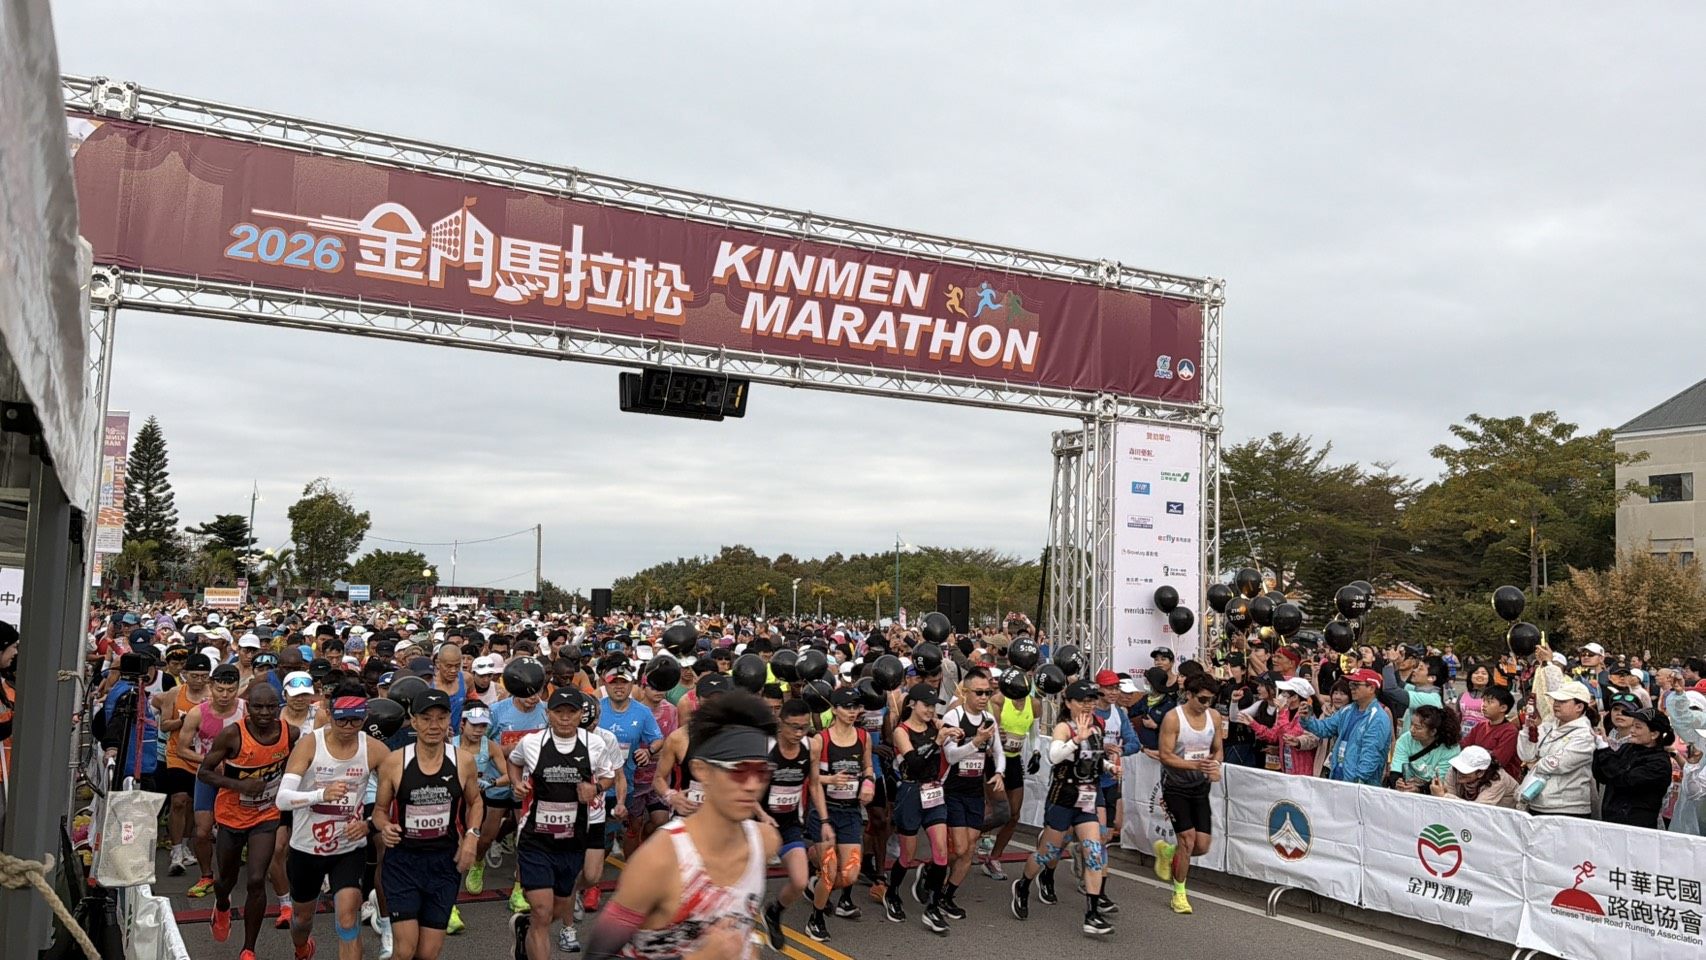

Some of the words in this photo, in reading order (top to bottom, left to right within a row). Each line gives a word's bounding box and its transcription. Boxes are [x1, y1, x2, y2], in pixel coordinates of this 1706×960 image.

[226, 223, 345, 272] 2026
[353, 197, 691, 324] 金門馬拉松
[712, 240, 931, 308] KINMEN
[740, 292, 1041, 371] MARATHON
[0, 591, 20, 606] 中
[1019, 644, 1037, 654] 5:00
[1005, 670, 1020, 685] 5:00
[1149, 781, 1161, 814] MINIST
[413, 817, 444, 828] 1009
[543, 813, 570, 824] 1013
[1406, 876, 1473, 907] 金門酒廠
[1608, 866, 1703, 905] 中華民國
[1550, 907, 1579, 919] Chinese
[1579, 912, 1603, 924] Taipei
[1604, 916, 1624, 929] Road
[1625, 921, 1655, 936] Running
[1656, 928, 1703, 946] Association
[1607, 895, 1704, 935] 路跑協會
